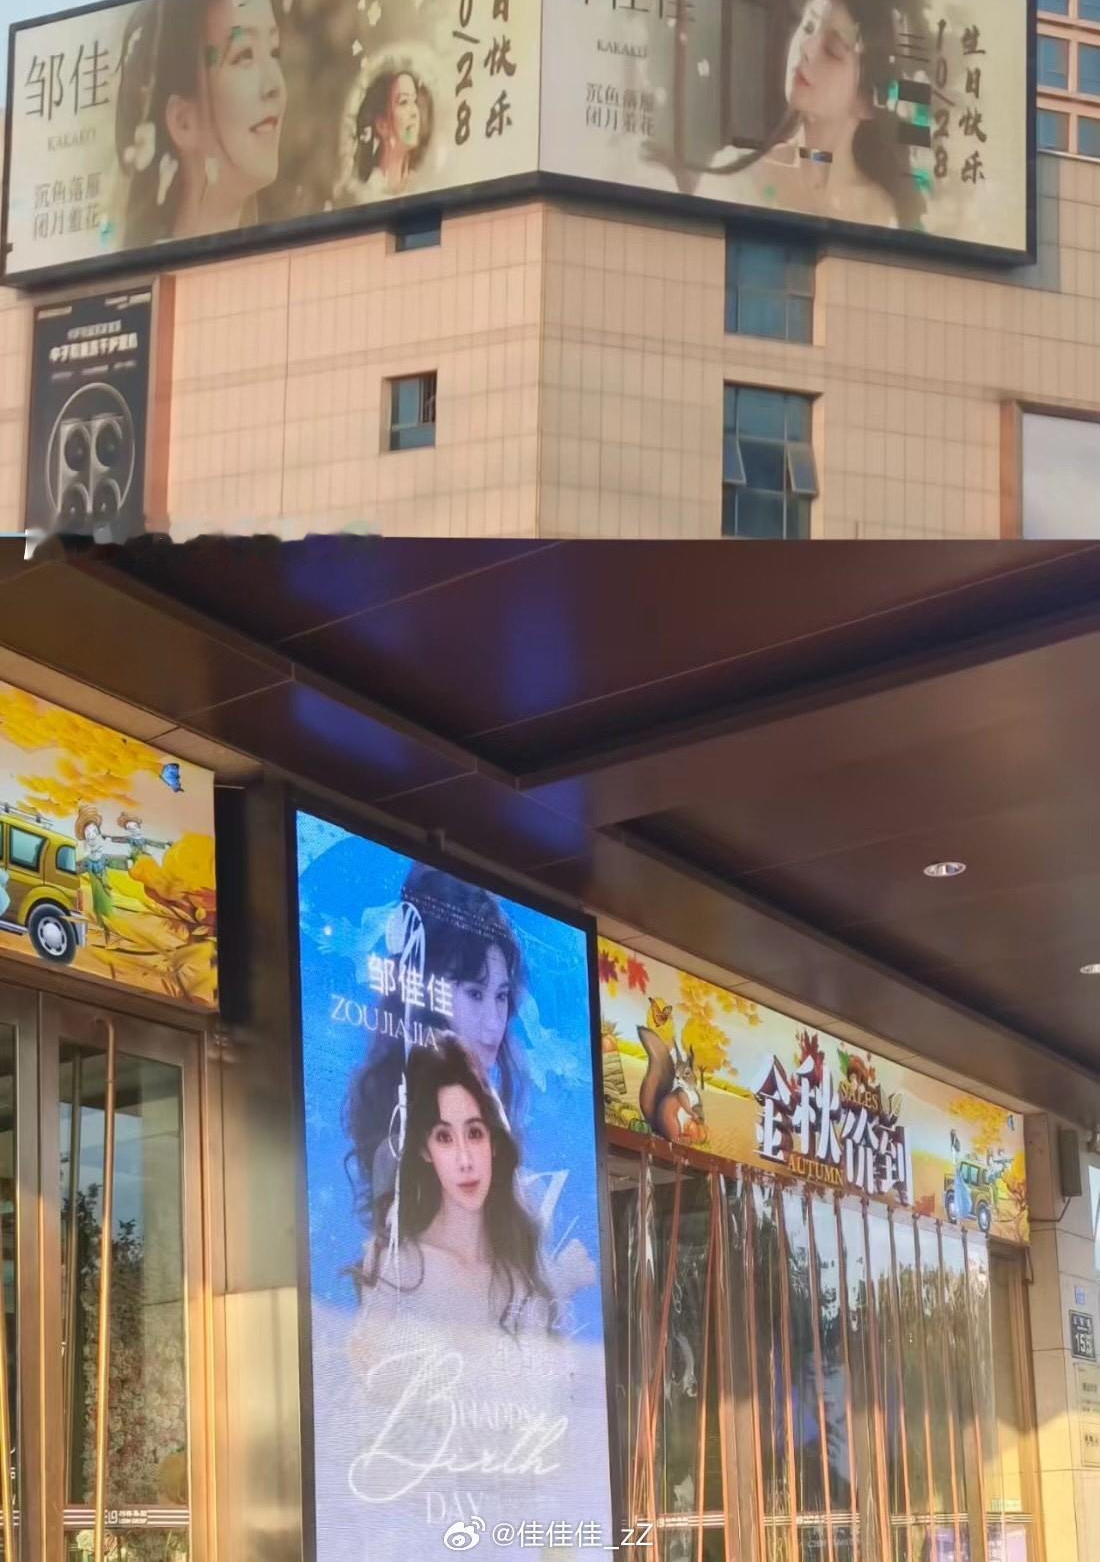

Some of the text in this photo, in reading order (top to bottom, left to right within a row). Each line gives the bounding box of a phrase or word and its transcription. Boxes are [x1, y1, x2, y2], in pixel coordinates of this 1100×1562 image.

[24, 39, 125, 121] 邹佳
[958, 24, 988, 184] 生日快乐
[366, 952, 454, 1017] 邹佳佳
[839, 1081, 879, 1111] SALES
[787, 1155, 844, 1185] AUTUMN
